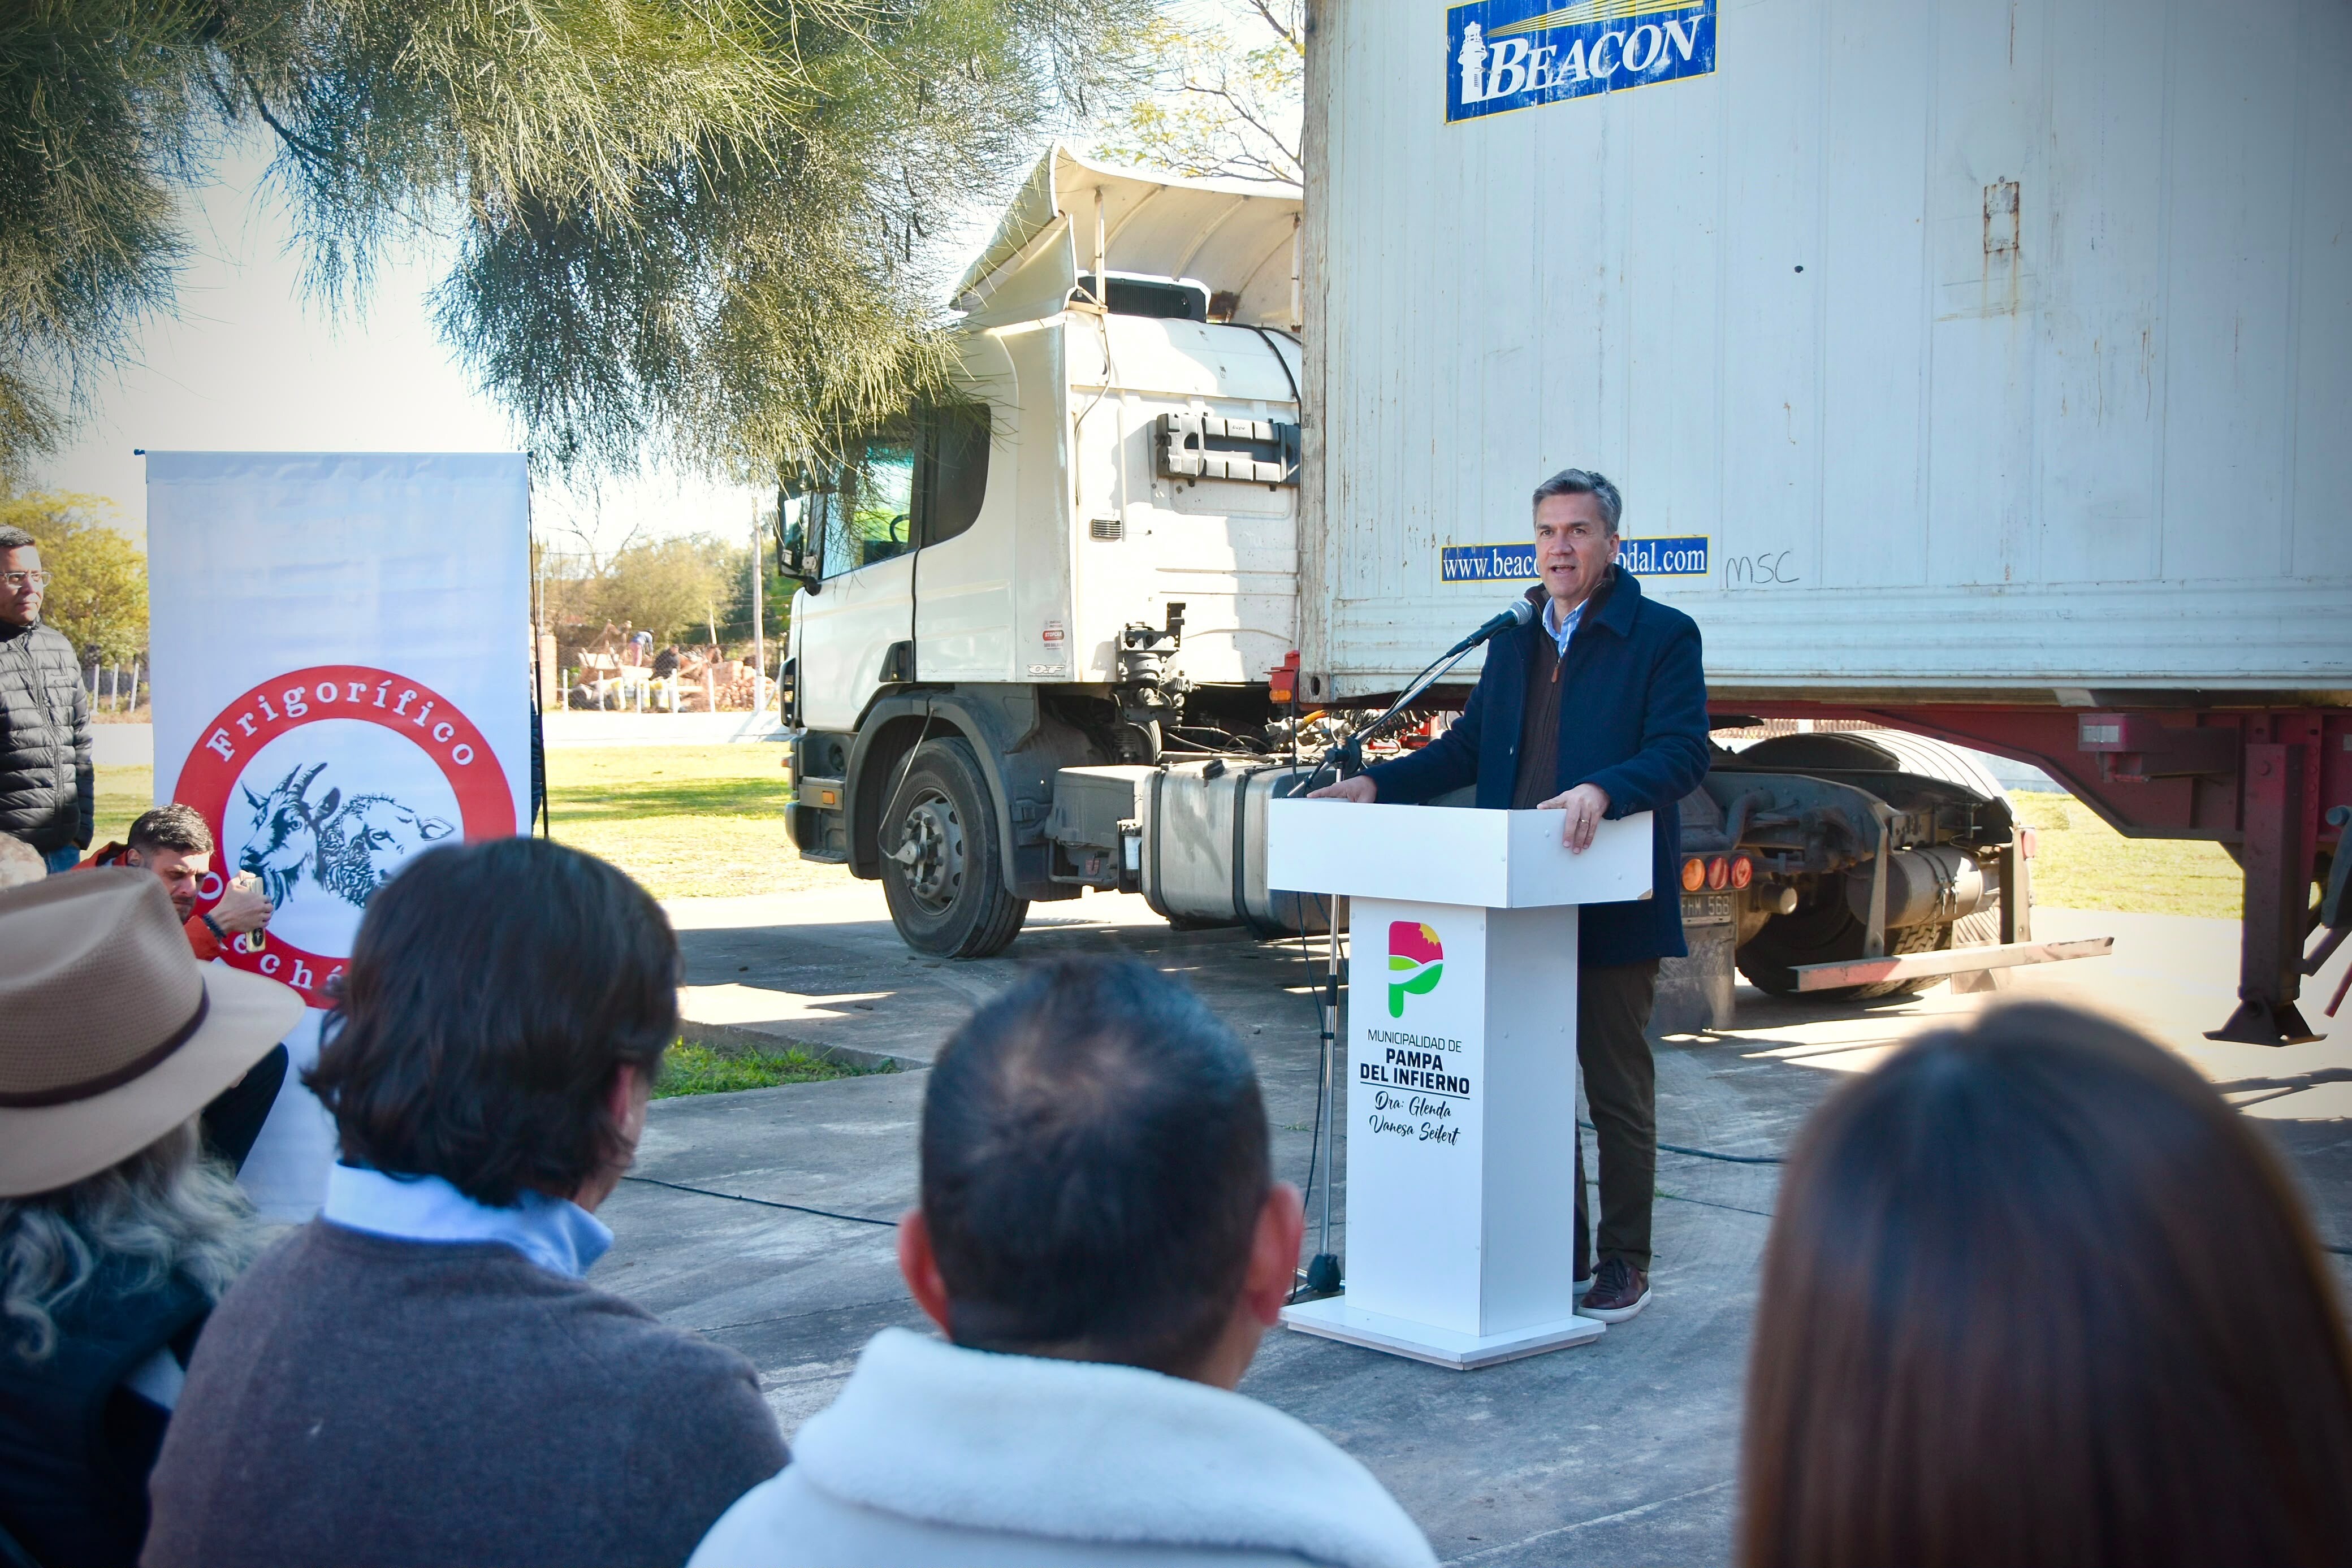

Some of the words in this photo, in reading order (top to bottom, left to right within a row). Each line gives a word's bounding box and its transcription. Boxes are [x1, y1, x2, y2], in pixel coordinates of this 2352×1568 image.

[1482, 15, 1705, 99] BEACON
[1726, 550, 1800, 588] MSC
[206, 679, 474, 765] Frigorífico
[1708, 895, 1730, 915] 568
[1368, 1029, 1445, 1051] MUNICIPALIDAD
[1449, 1039, 1462, 1053] DE
[1386, 1047, 1443, 1071] PAMPA
[1360, 1063, 1389, 1082] DEL
[1394, 1068, 1470, 1094] INFIERNO
[1409, 1096, 1451, 1119] Glenda
[1369, 1115, 1415, 1136] Vanesa
[1419, 1121, 1460, 1146] Seifert
